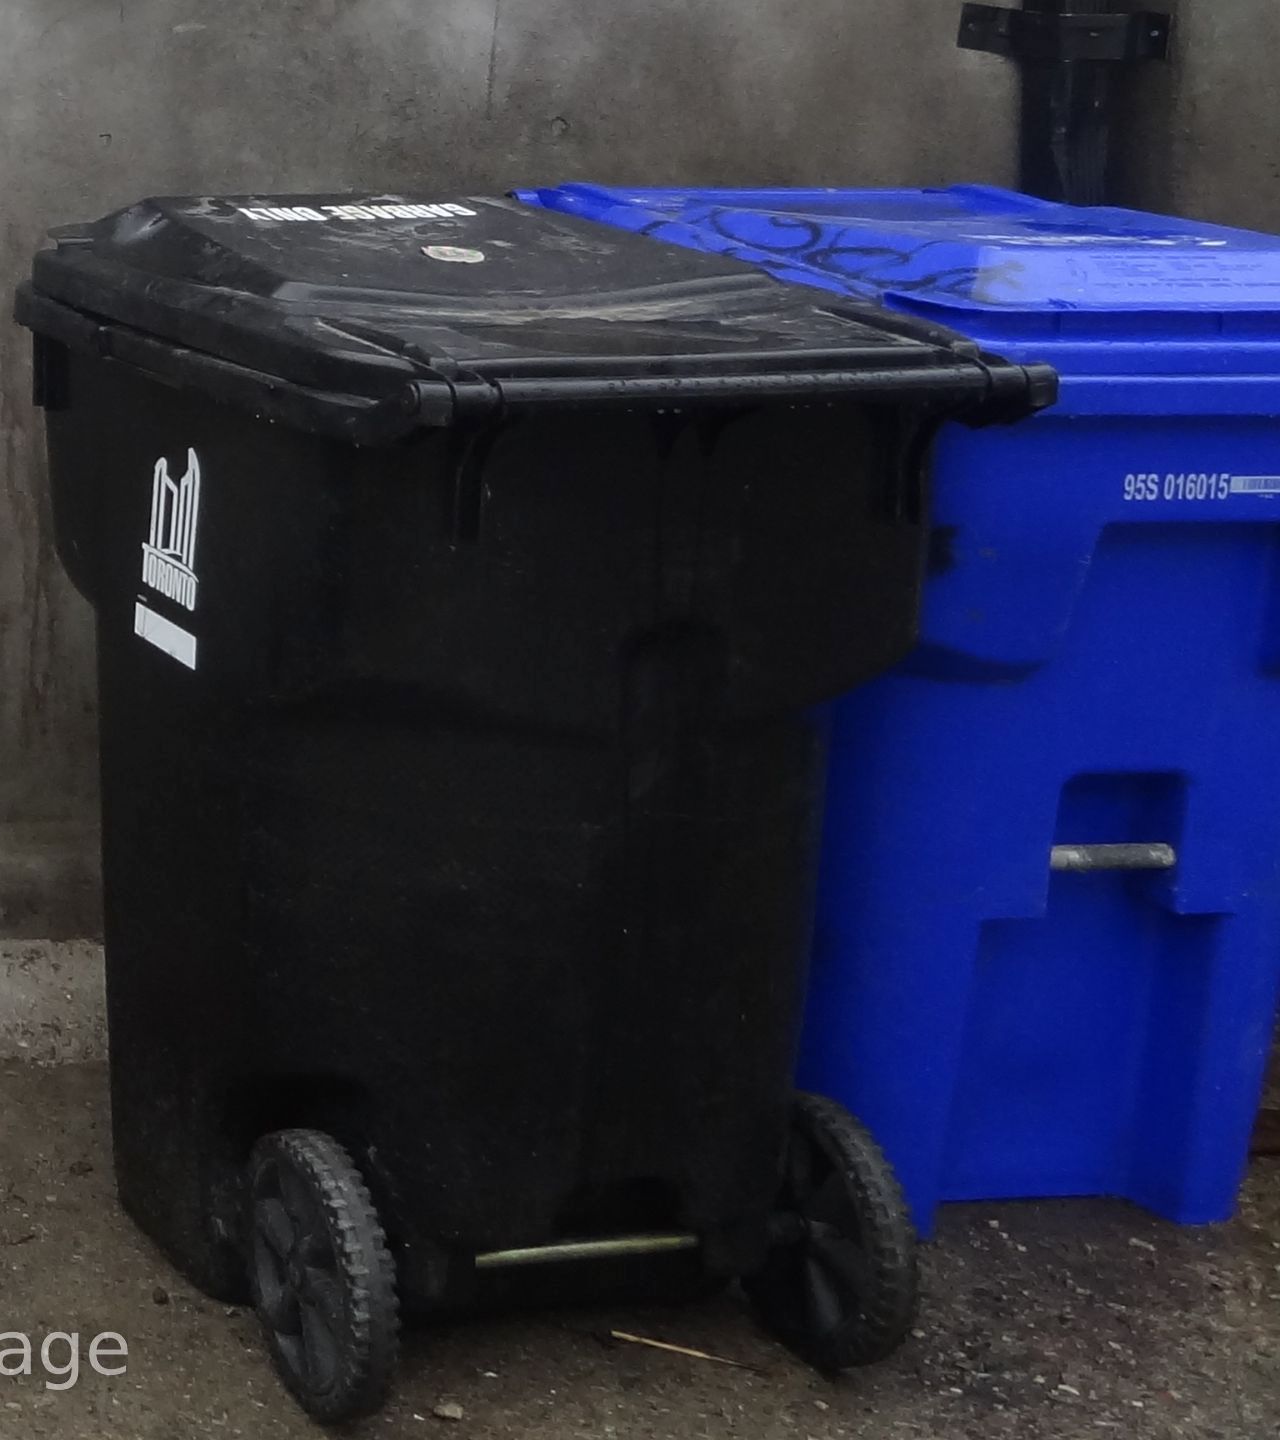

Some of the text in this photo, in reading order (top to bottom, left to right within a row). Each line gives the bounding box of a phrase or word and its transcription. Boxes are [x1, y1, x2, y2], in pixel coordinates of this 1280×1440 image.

[237, 202, 478, 222] GARBAGE ONLY
[1163, 473, 1231, 501] 016015
[142, 542, 199, 611] TORONTO
